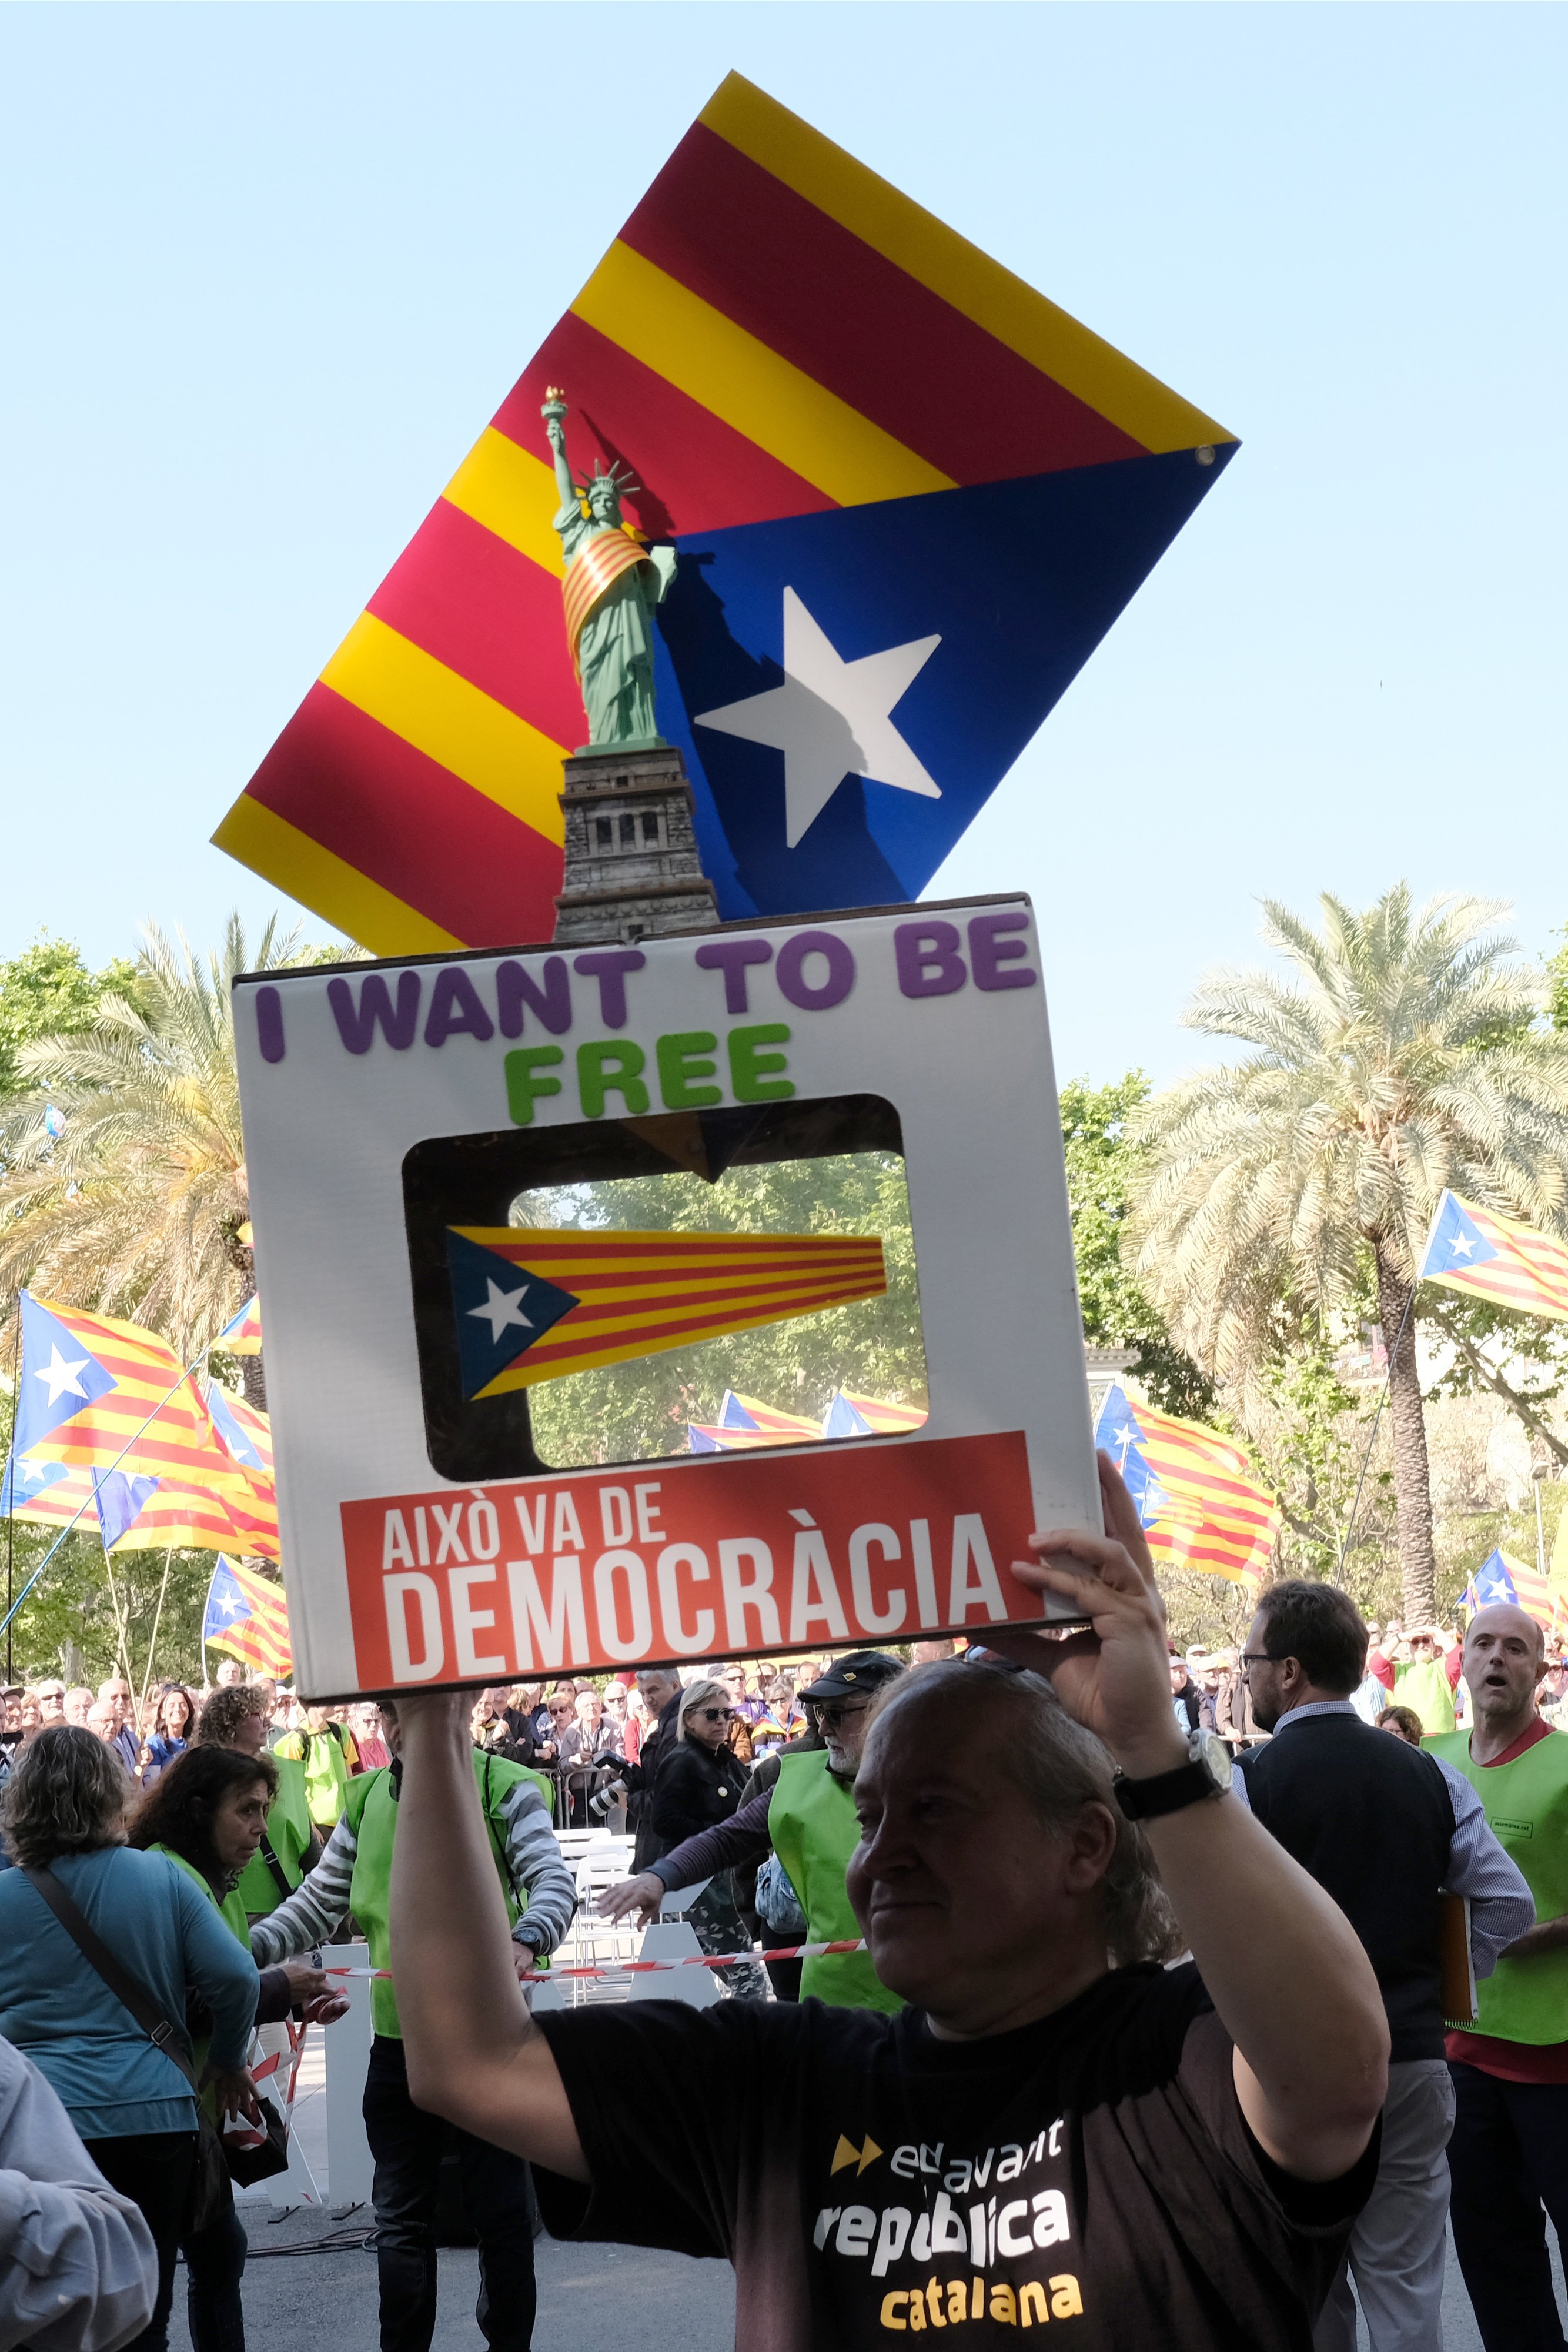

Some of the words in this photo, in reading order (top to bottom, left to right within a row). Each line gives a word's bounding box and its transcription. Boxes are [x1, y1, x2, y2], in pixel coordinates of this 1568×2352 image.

[256, 986, 285, 1063] I
[327, 950, 646, 1055] WANT
[695, 931, 854, 1014] TO
[894, 913, 1037, 999] BE
[504, 1023, 795, 1125] FREE
[382, 1489, 500, 1570] AIXÒ
[514, 1491, 585, 1555] VA
[599, 1482, 666, 1547] DE
[382, 1509, 1008, 1684] DEMOCRÀCIA
[880, 2273, 1084, 2331] catalana
